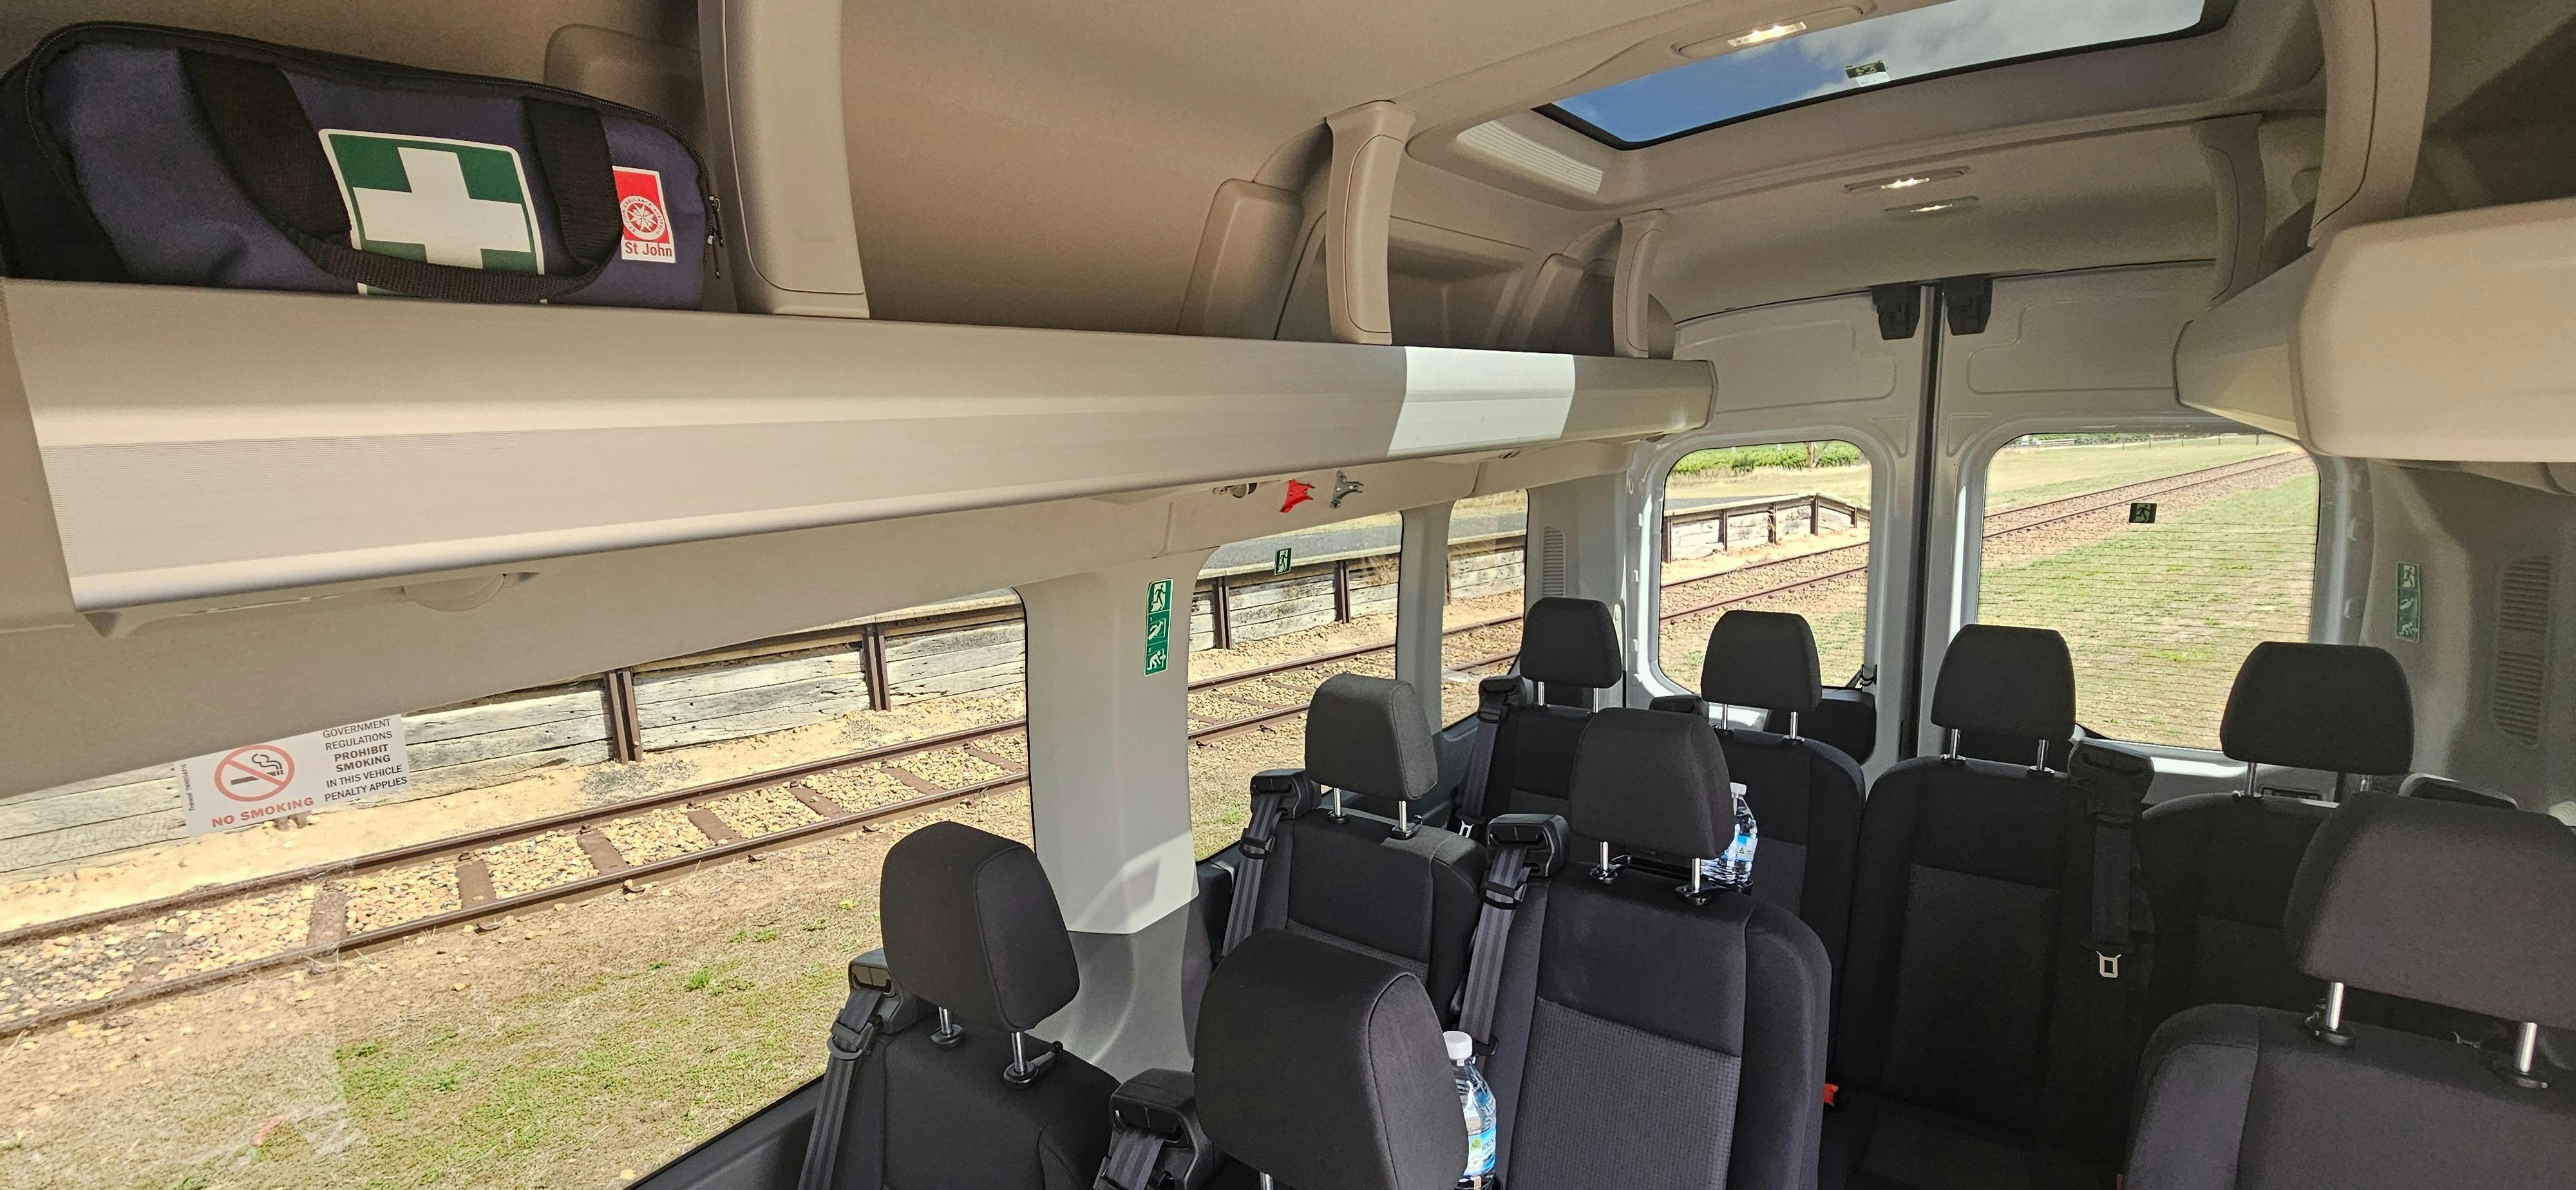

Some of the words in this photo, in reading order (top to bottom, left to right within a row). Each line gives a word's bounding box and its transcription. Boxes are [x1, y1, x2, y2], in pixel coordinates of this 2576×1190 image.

[625, 241, 638, 254] St
[643, 243, 672, 257] John
[323, 718, 391, 738] GOVERNMENT
[325, 731, 392, 750] REGULATIONS
[334, 744, 388, 762] PROHIBIT
[336, 755, 391, 772] SMOKING
[327, 779, 337, 788] IN
[338, 774, 361, 785] THIS
[363, 764, 402, 780] VEHICLE
[325, 785, 367, 802] PENALTY
[369, 777, 408, 791] APPLIES
[211, 815, 235, 827] NO
[240, 797, 314, 820] SMOKING
